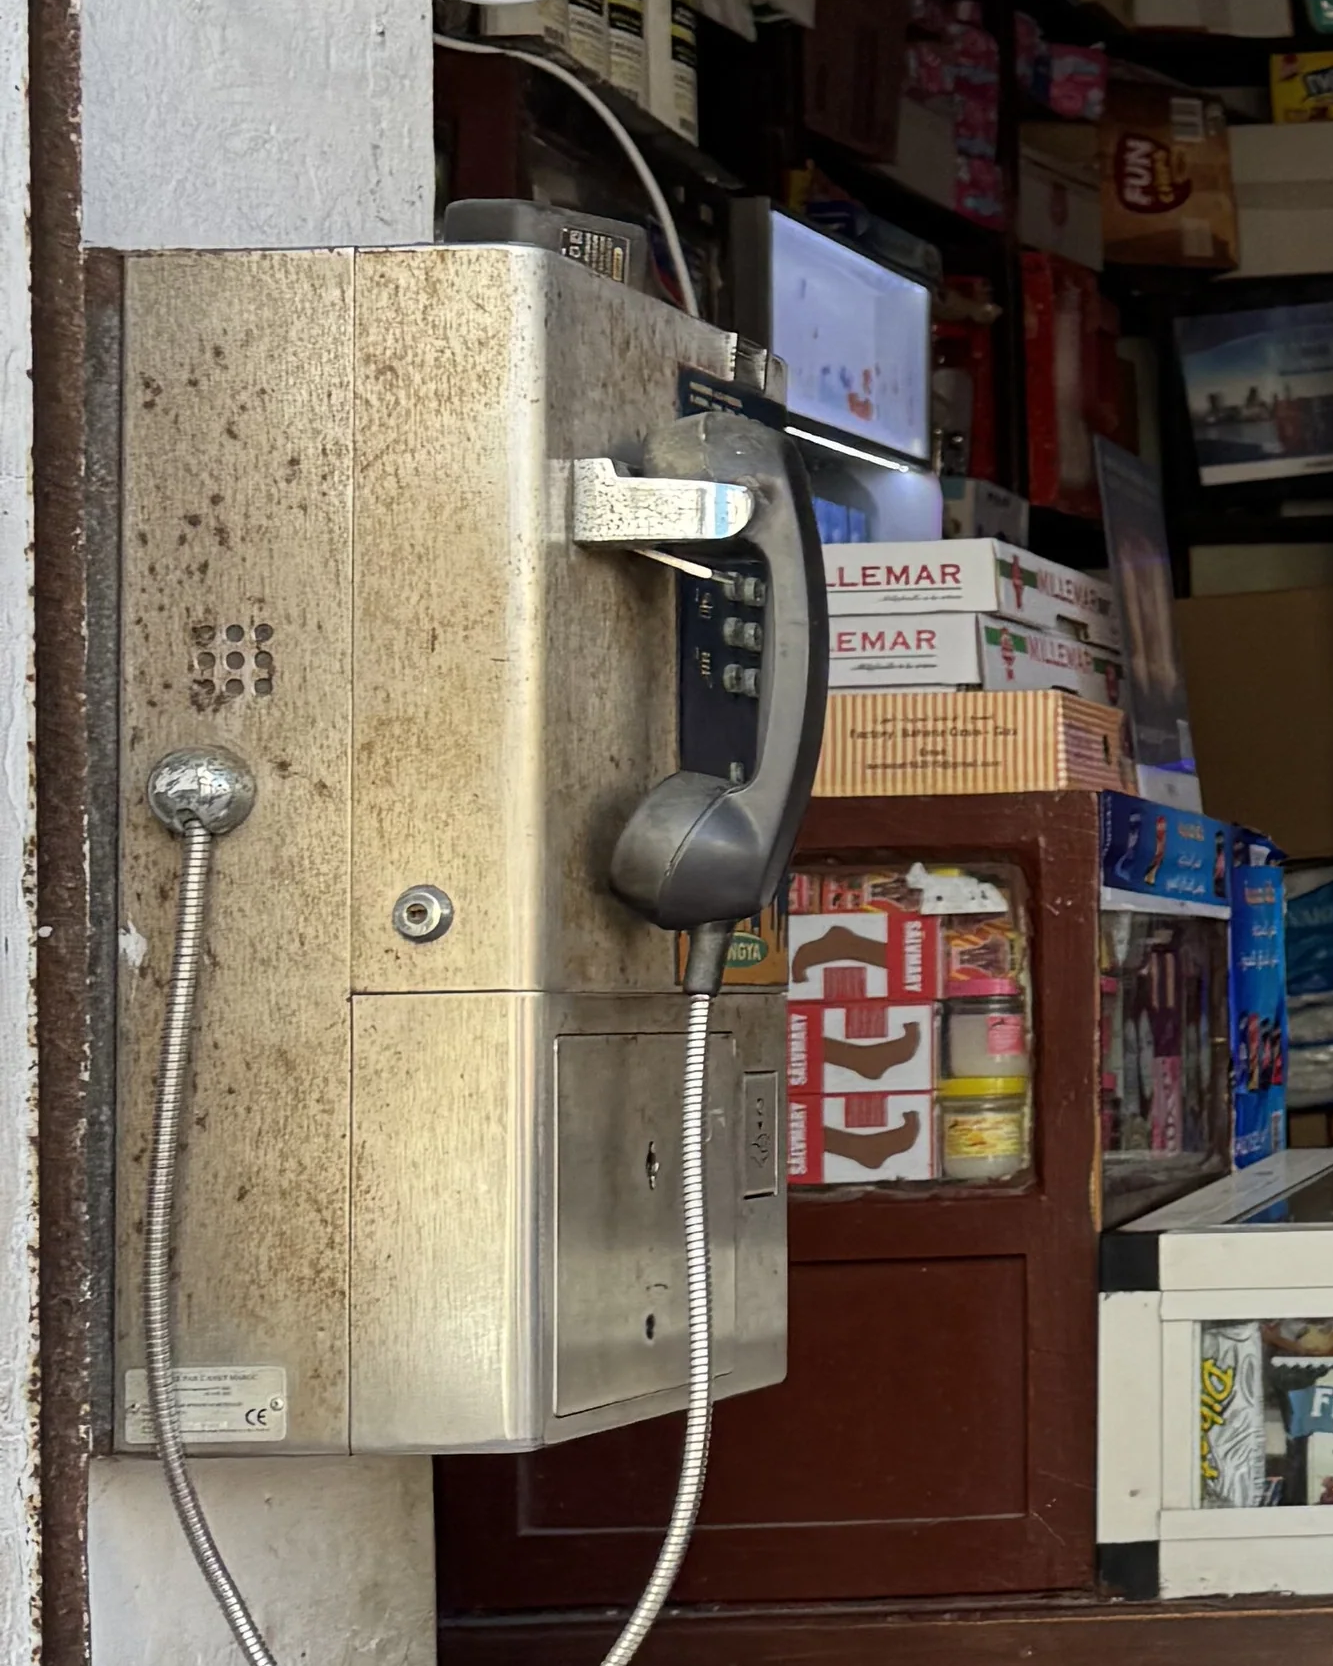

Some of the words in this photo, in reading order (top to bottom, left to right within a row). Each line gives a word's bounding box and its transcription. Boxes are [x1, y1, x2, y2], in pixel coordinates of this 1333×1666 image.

[1123, 136, 1157, 208] FUN
[827, 562, 962, 589] LEMAR
[829, 628, 938, 653] EMAR
[244, 1408, 268, 1426] CE
